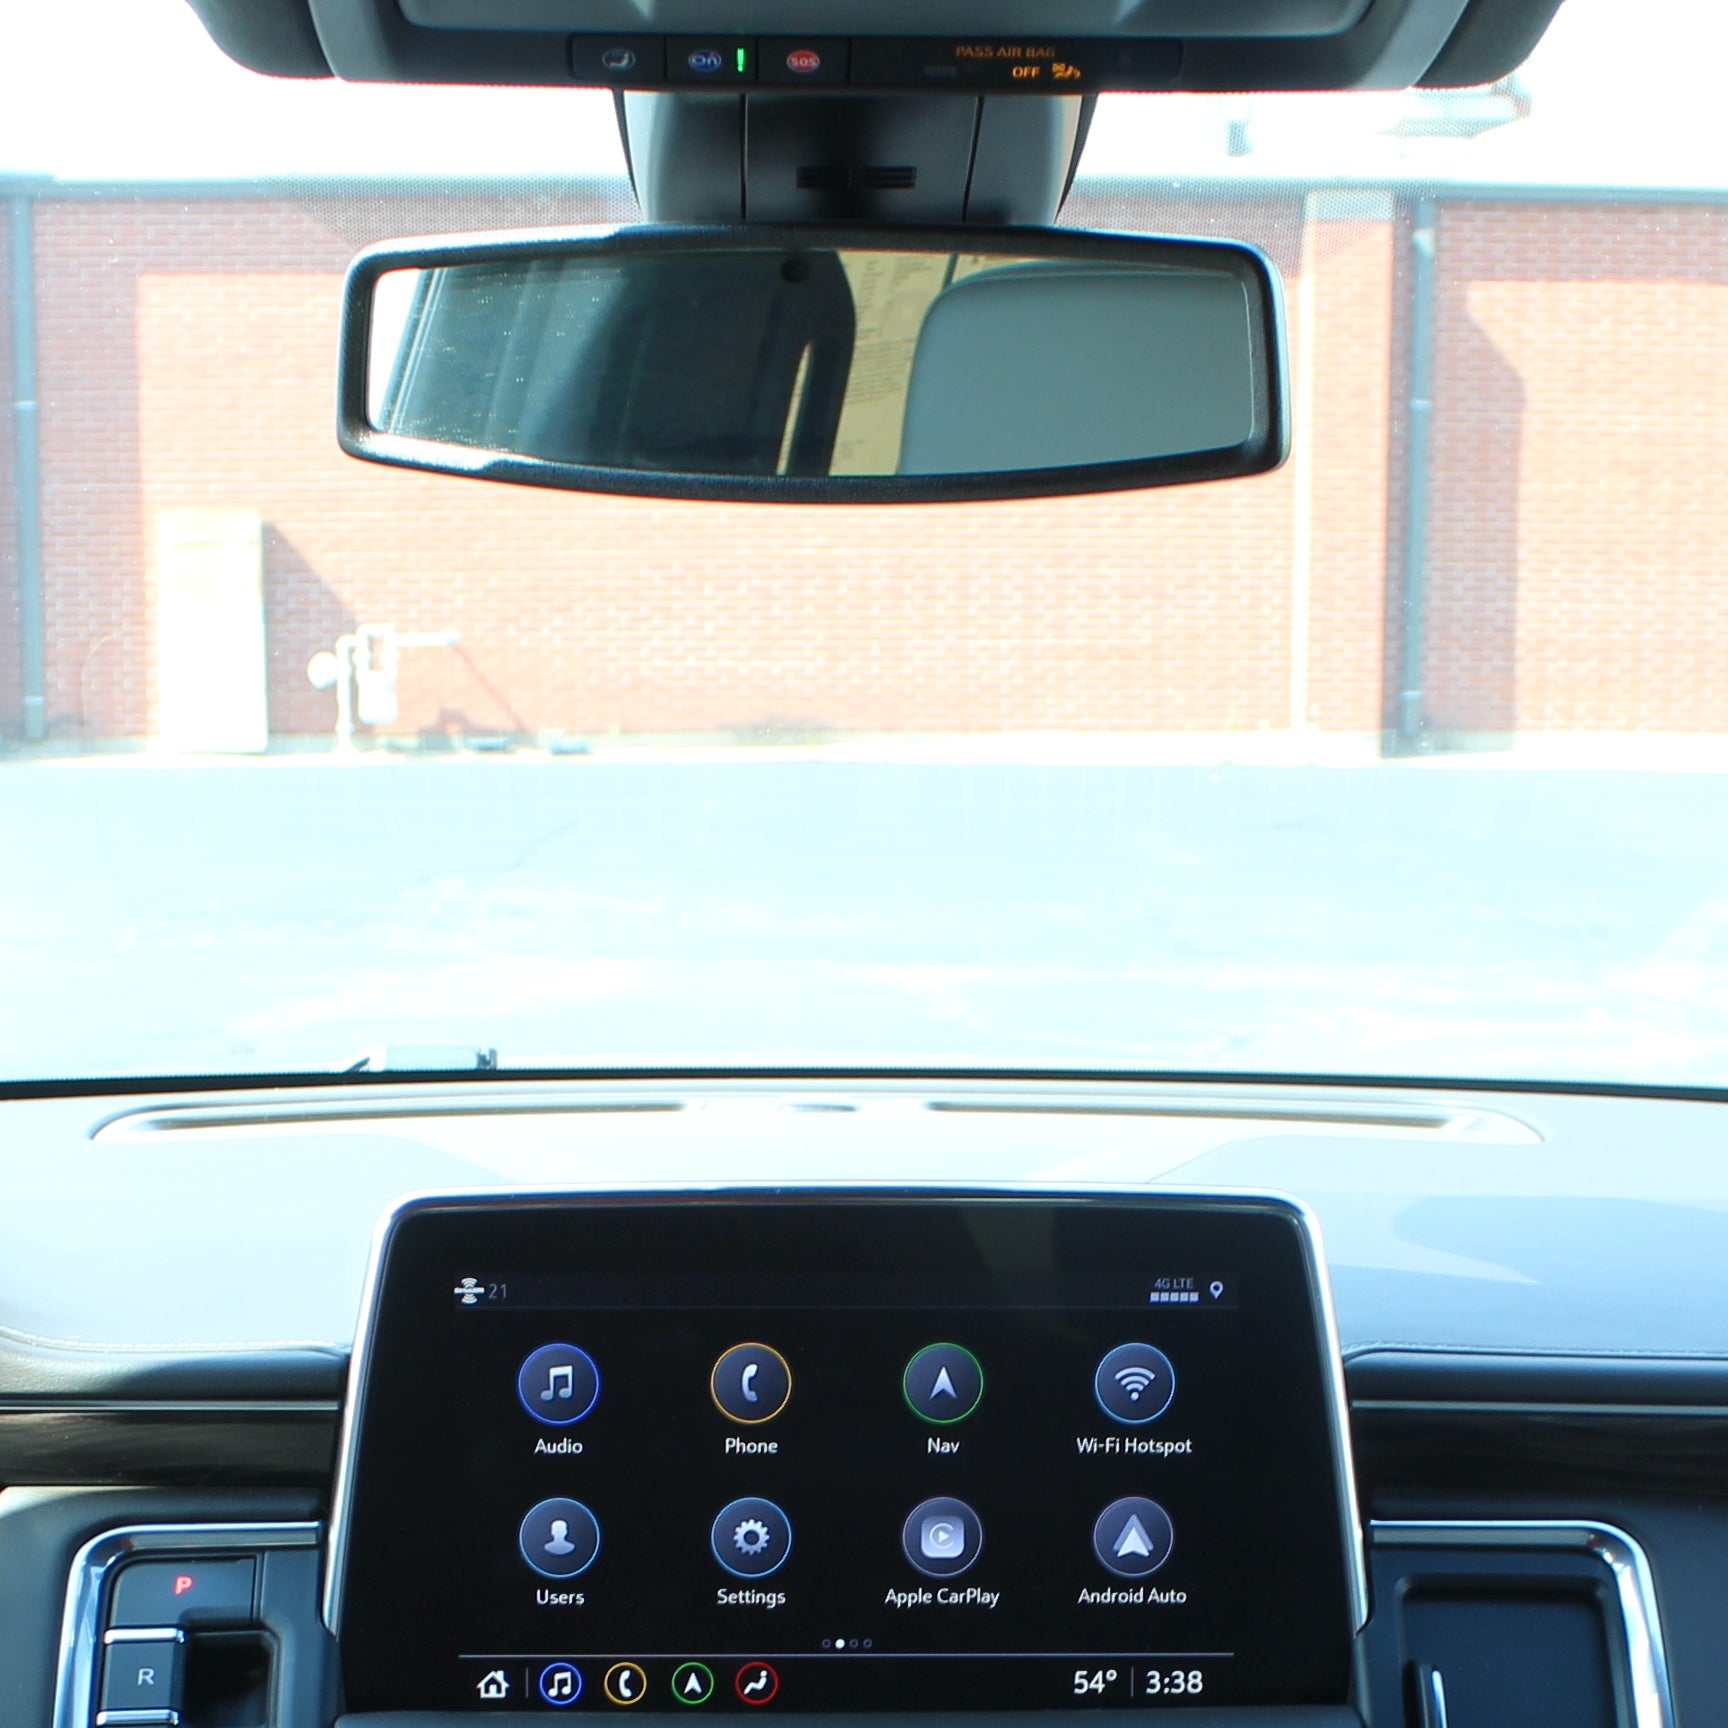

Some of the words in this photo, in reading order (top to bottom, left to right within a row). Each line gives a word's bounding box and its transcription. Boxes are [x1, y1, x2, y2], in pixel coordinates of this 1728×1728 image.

[955, 45, 993, 58] PASS
[996, 45, 1022, 58] AIR
[1025, 46, 1056, 58] BAG
[1011, 65, 1041, 79] OFF
[488, 1283, 507, 1299] 21
[1154, 1277, 1171, 1290] 4G
[1173, 1277, 1195, 1290] LTE
[534, 1436, 584, 1454] Audio
[725, 1436, 779, 1454] Phone
[927, 1437, 961, 1454] Nav
[1076, 1436, 1121, 1454] Wi-Fi
[1124, 1436, 1194, 1458] Hotspot
[173, 1575, 194, 1596] P
[535, 1588, 586, 1606] Users
[717, 1588, 787, 1609] Settings
[883, 1587, 934, 1609] Apple
[937, 1587, 1001, 1609] CarPlay
[1077, 1586, 1144, 1605] Android
[1146, 1587, 1188, 1605] Auto
[137, 1667, 156, 1687] R
[1072, 1668, 1119, 1696] 54°
[1144, 1669, 1205, 1696] 3:38
